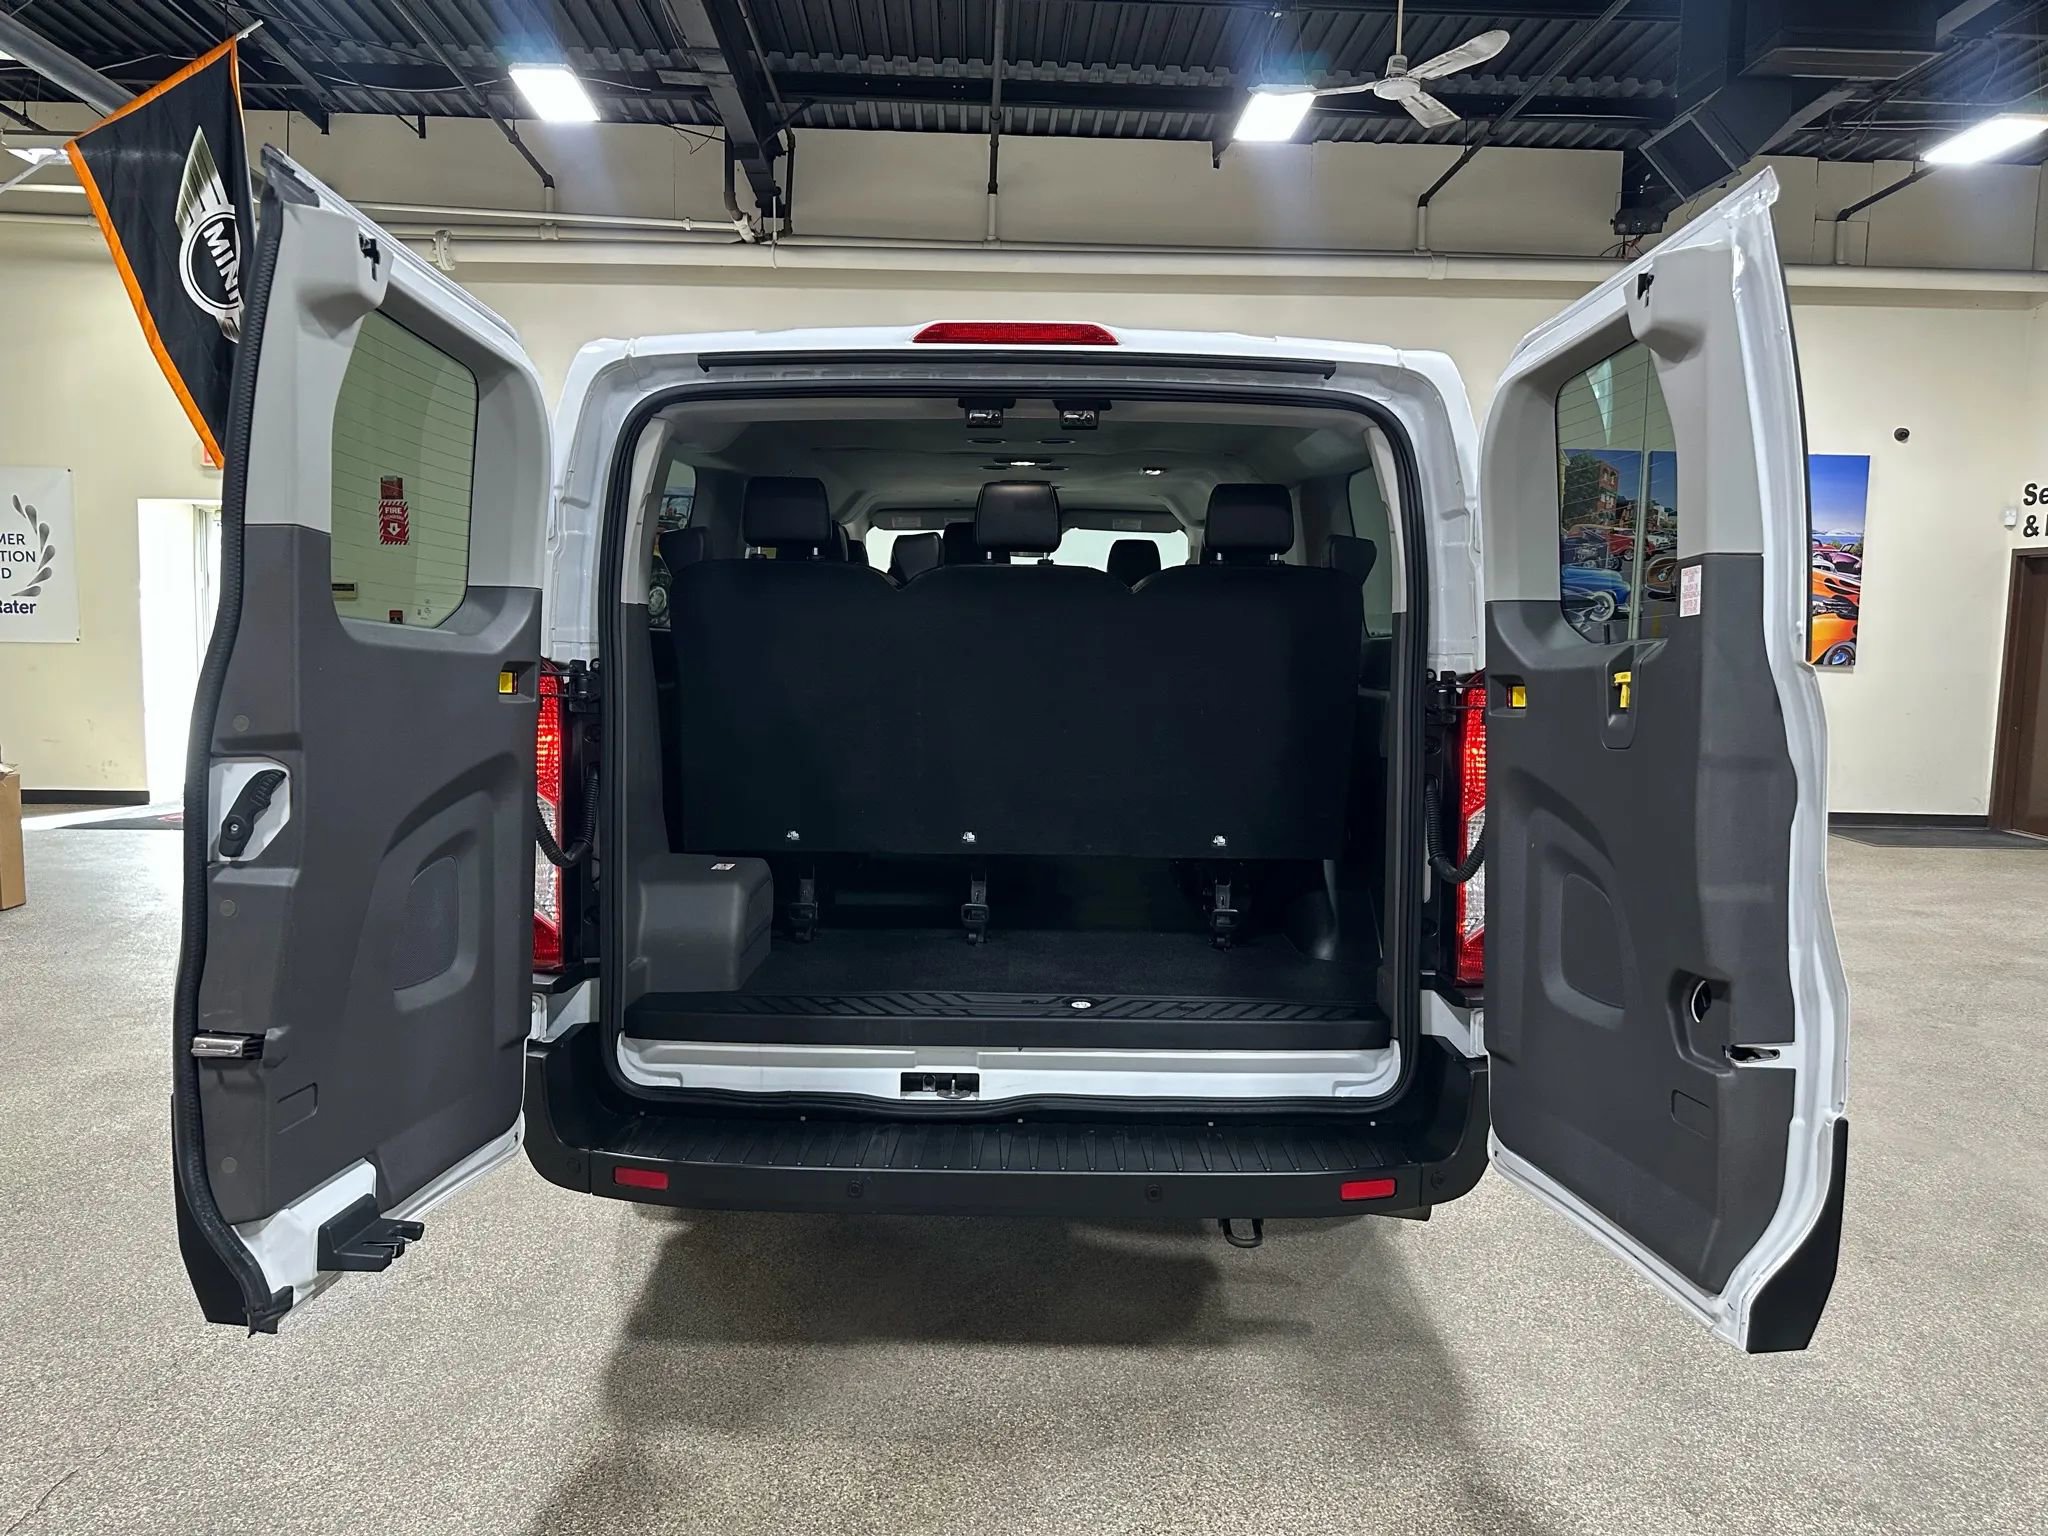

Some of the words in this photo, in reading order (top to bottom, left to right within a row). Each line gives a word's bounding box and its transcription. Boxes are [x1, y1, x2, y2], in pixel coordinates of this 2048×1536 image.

[2023, 482, 2048, 506] Se
[384, 506, 403, 515] FIRE
[2023, 514, 2040, 538] &
[0, 550, 36, 562] TION
[1, 567, 12, 579] D
[0, 600, 37, 614] ater
